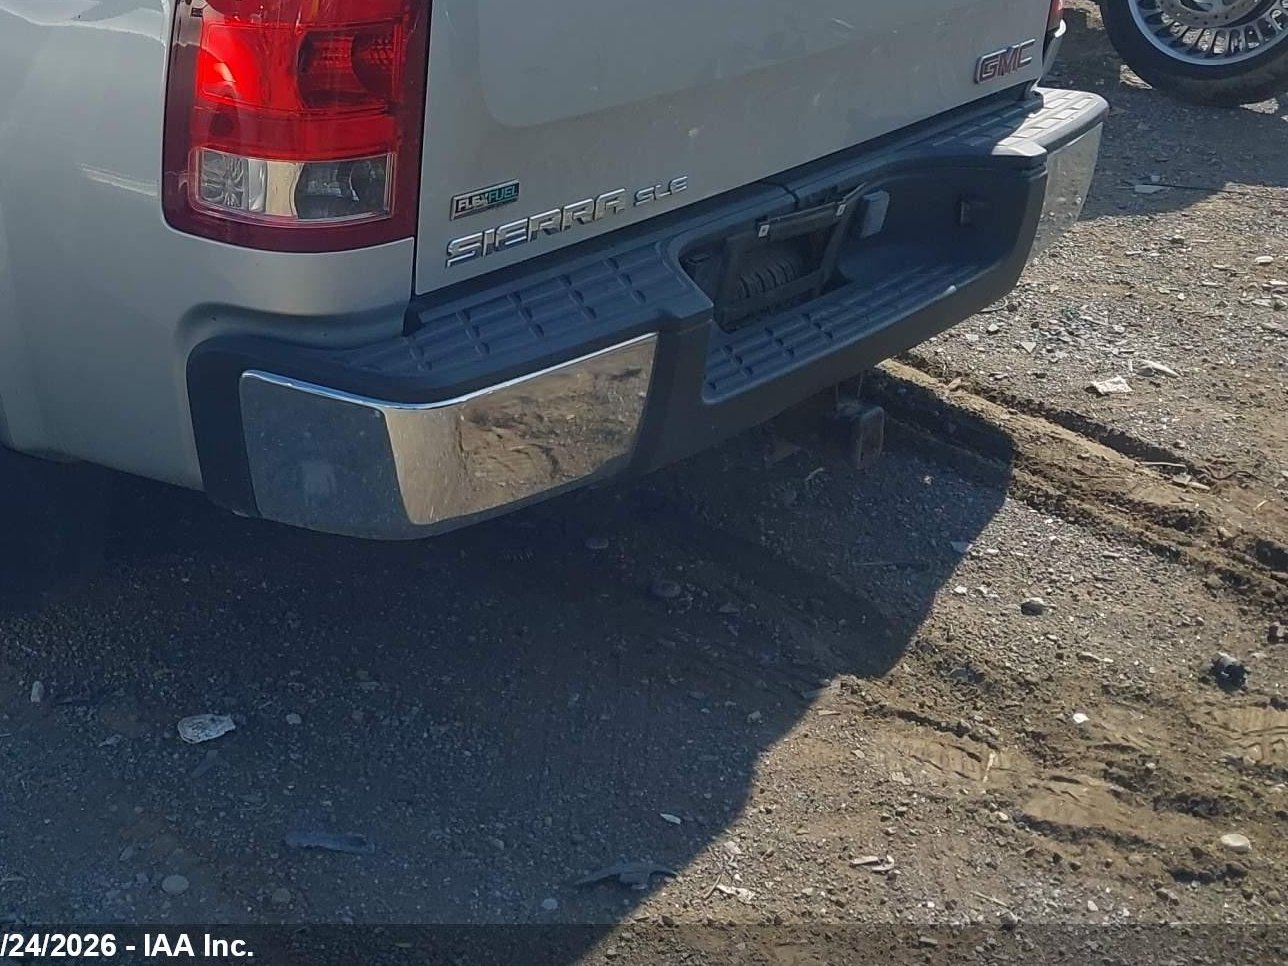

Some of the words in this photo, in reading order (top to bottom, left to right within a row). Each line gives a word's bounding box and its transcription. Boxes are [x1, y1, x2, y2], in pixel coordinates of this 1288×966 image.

[975, 38, 1036, 84] GMC
[446, 188, 626, 268] SIERRA
[634, 176, 689, 207] SLE
